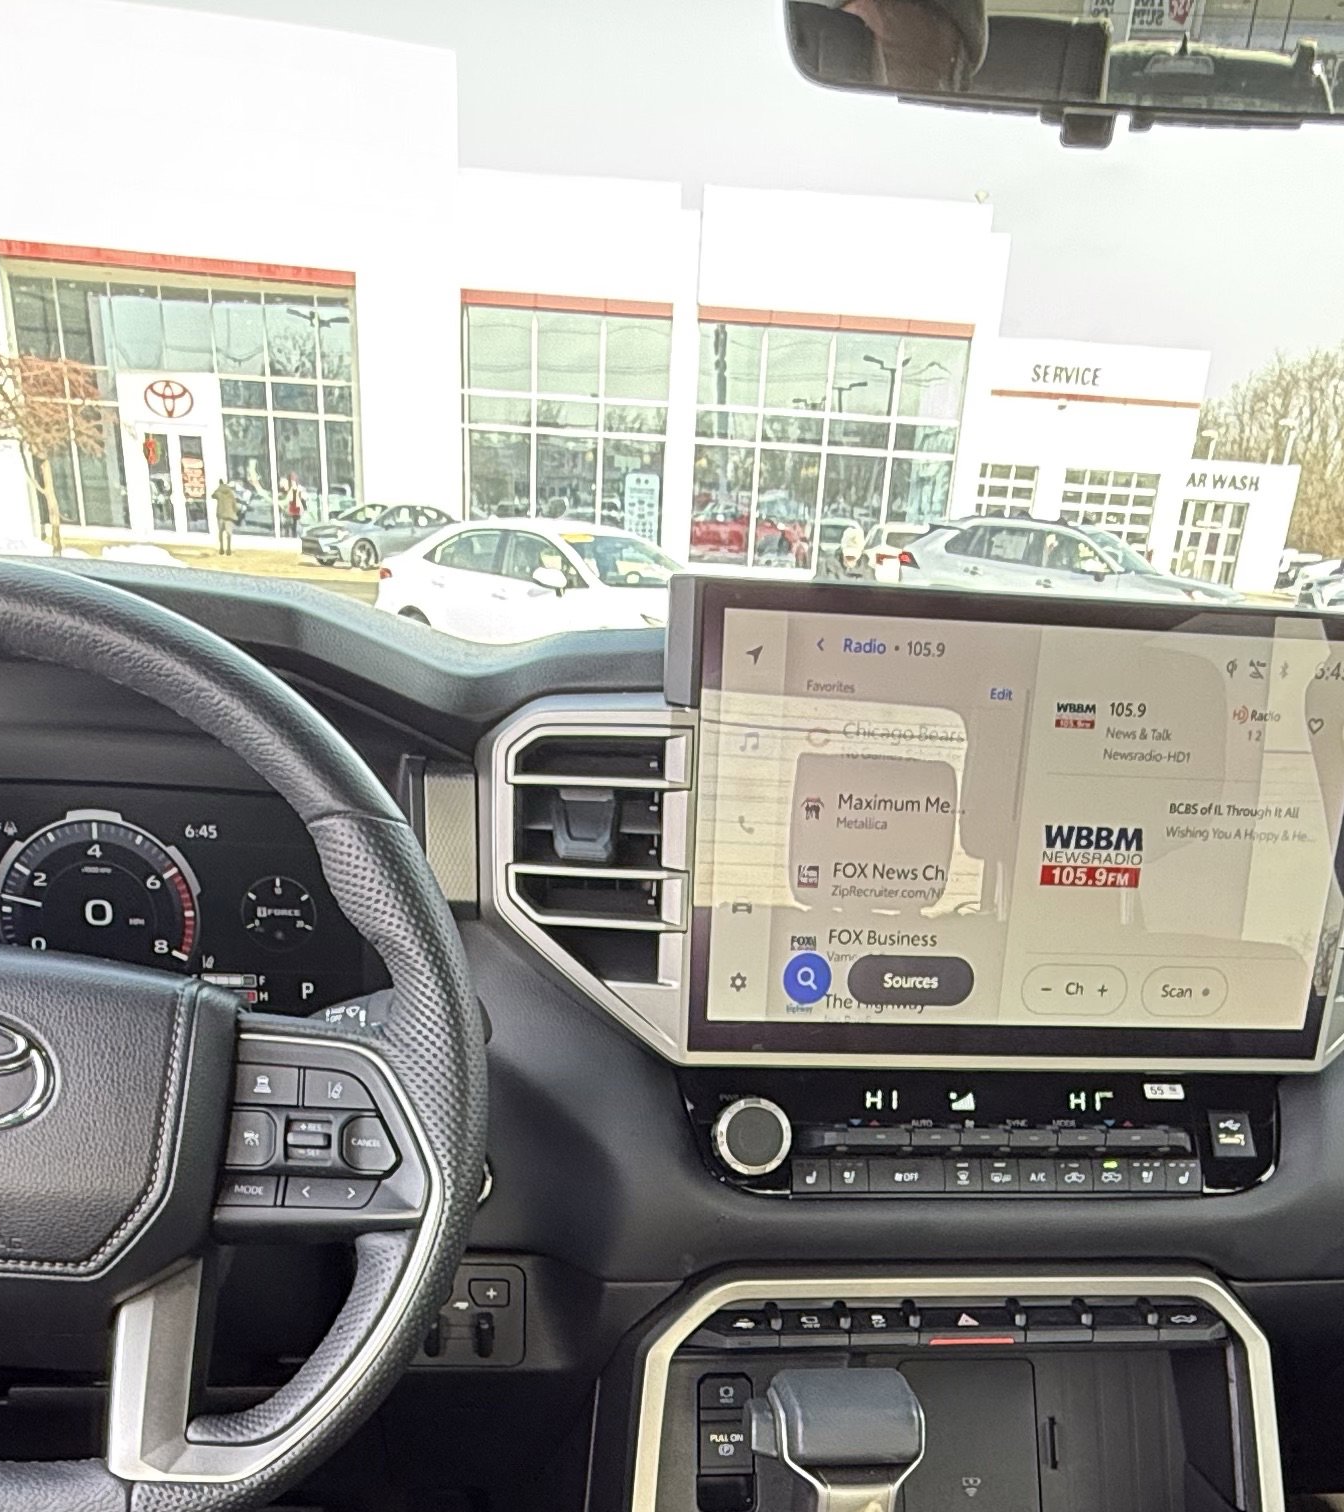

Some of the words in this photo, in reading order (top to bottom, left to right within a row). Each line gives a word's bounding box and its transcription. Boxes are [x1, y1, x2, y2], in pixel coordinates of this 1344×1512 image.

[1032, 364, 1102, 386] SERVICE
[1212, 475, 1260, 491] WASH
[843, 637, 887, 655] Radio
[906, 640, 946, 657] 105.9
[806, 679, 856, 694] Favorites
[990, 687, 1013, 701] Edit
[1056, 701, 1097, 715] WBBM
[1107, 702, 1146, 718] 105.9
[1106, 727, 1136, 740] News
[1139, 729, 1148, 740] &
[1151, 729, 1172, 741] Talk
[1103, 748, 1191, 763] Newsradio-HD1
[838, 793, 921, 813] Maximum
[1169, 803, 1199, 815] BCBS
[1200, 803, 1213, 816] of
[1226, 805, 1272, 820] Through
[1284, 807, 1300, 819] All
[836, 816, 888, 830] Metallica
[184, 824, 218, 839] 6:45
[1044, 824, 1144, 851] WBBM
[1166, 826, 1210, 842] Wishing
[1211, 828, 1233, 840] You
[86, 843, 103, 858] 4
[1041, 850, 1143, 866] NEWSRADIO
[33, 871, 47, 886] 2
[833, 862, 869, 879] FOX
[872, 864, 917, 880] News
[1051, 866, 1130, 886] 105.9FM
[146, 874, 161, 890] 6
[84, 899, 114, 926] 0
[828, 928, 864, 946] FOX
[867, 930, 938, 948] Business
[153, 939, 169, 954] 8
[883, 972, 939, 990] Sources
[1065, 981, 1084, 996] Ch
[301, 981, 315, 1000] P
[1161, 984, 1193, 999] Scan
[825, 992, 854, 1010] The
[865, 1089, 899, 1110] HI
[911, 1119, 933, 1128] AUTO
[351, 1137, 382, 1148] CANCEL
[1029, 1172, 1047, 1183] A/C
[234, 1184, 264, 1195] MODE
[710, 1433, 728, 1443] PULL
[730, 1433, 744, 1443] ON
